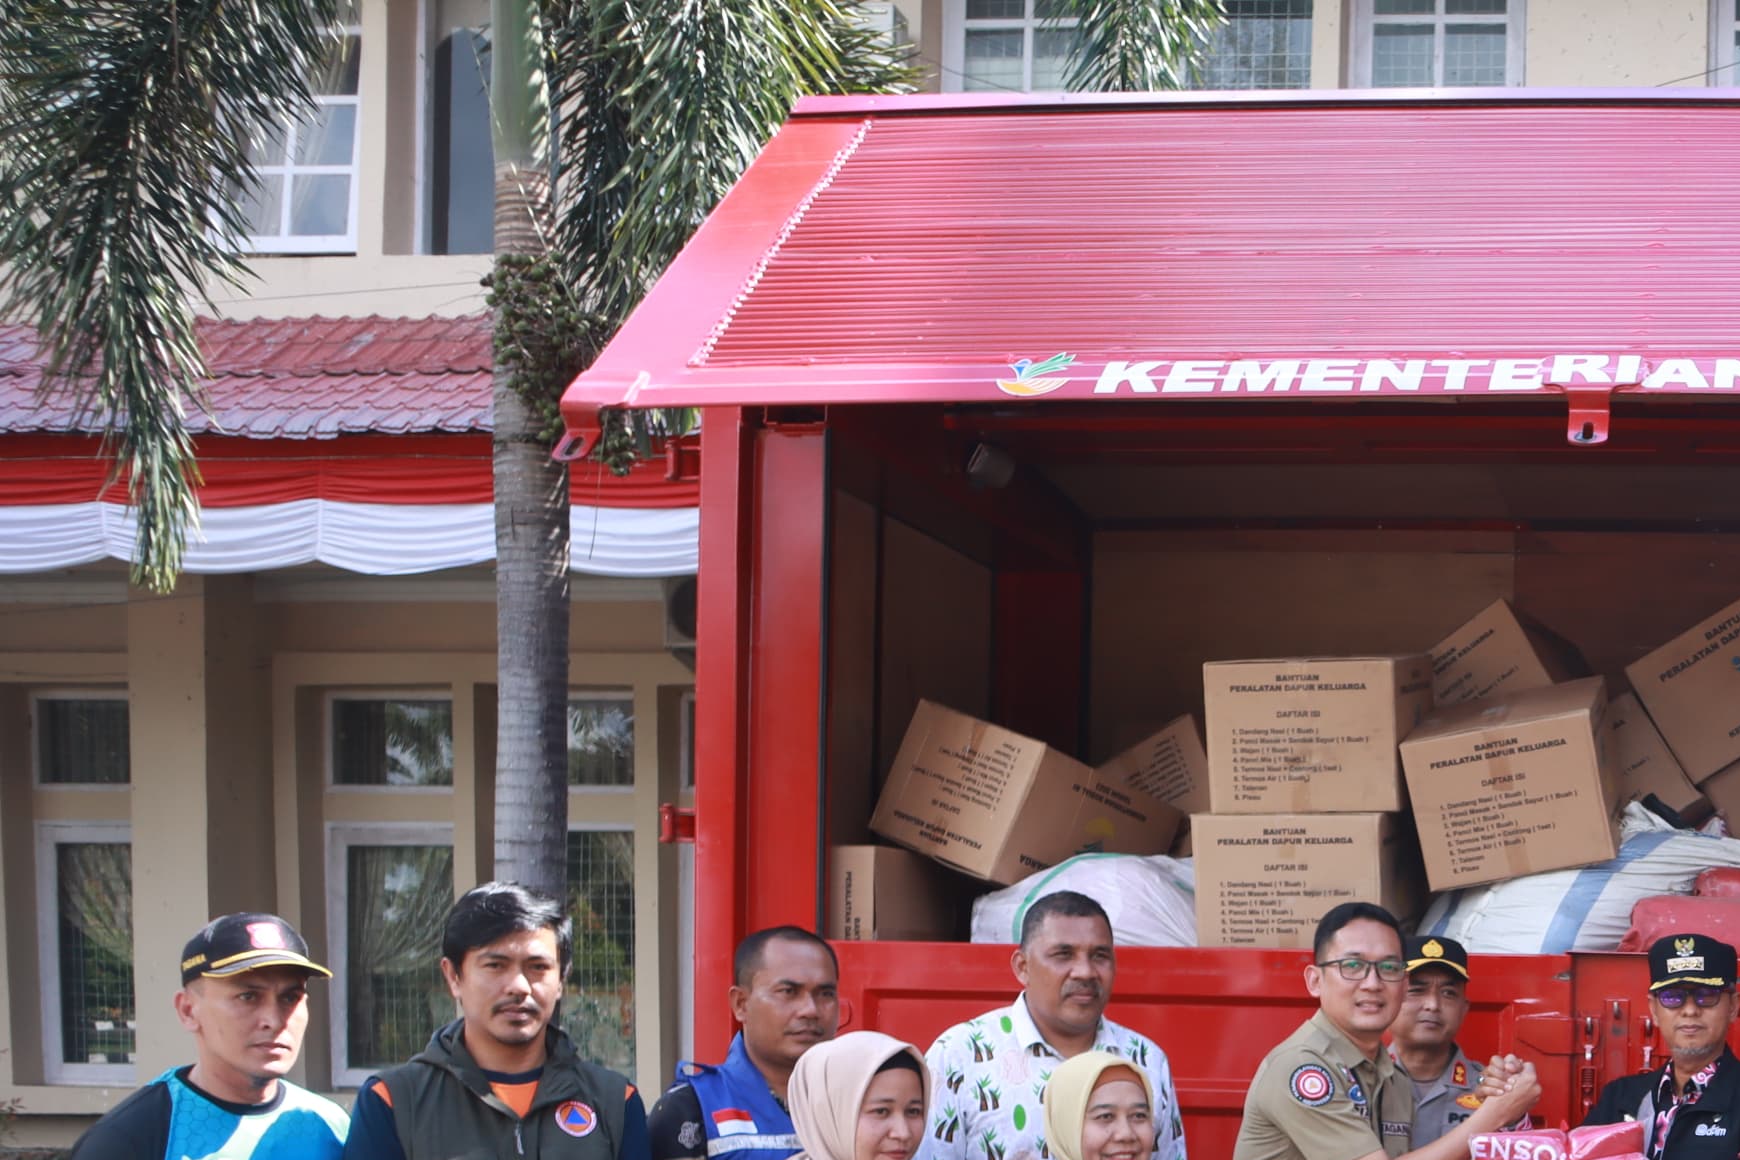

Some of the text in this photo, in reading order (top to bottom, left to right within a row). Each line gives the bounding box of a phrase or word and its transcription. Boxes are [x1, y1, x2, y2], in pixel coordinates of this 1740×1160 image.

[1659, 642, 1720, 682] PERALATAN
[1276, 674, 1319, 682] BANTUAN
[1276, 710, 1321, 718] DAFTAR ISI
[1474, 738, 1518, 751] BANTUAN
[1430, 739, 1566, 769] PERALATAN DAPUR KELUARGA
[1481, 775, 1513, 787] DAFTAR
